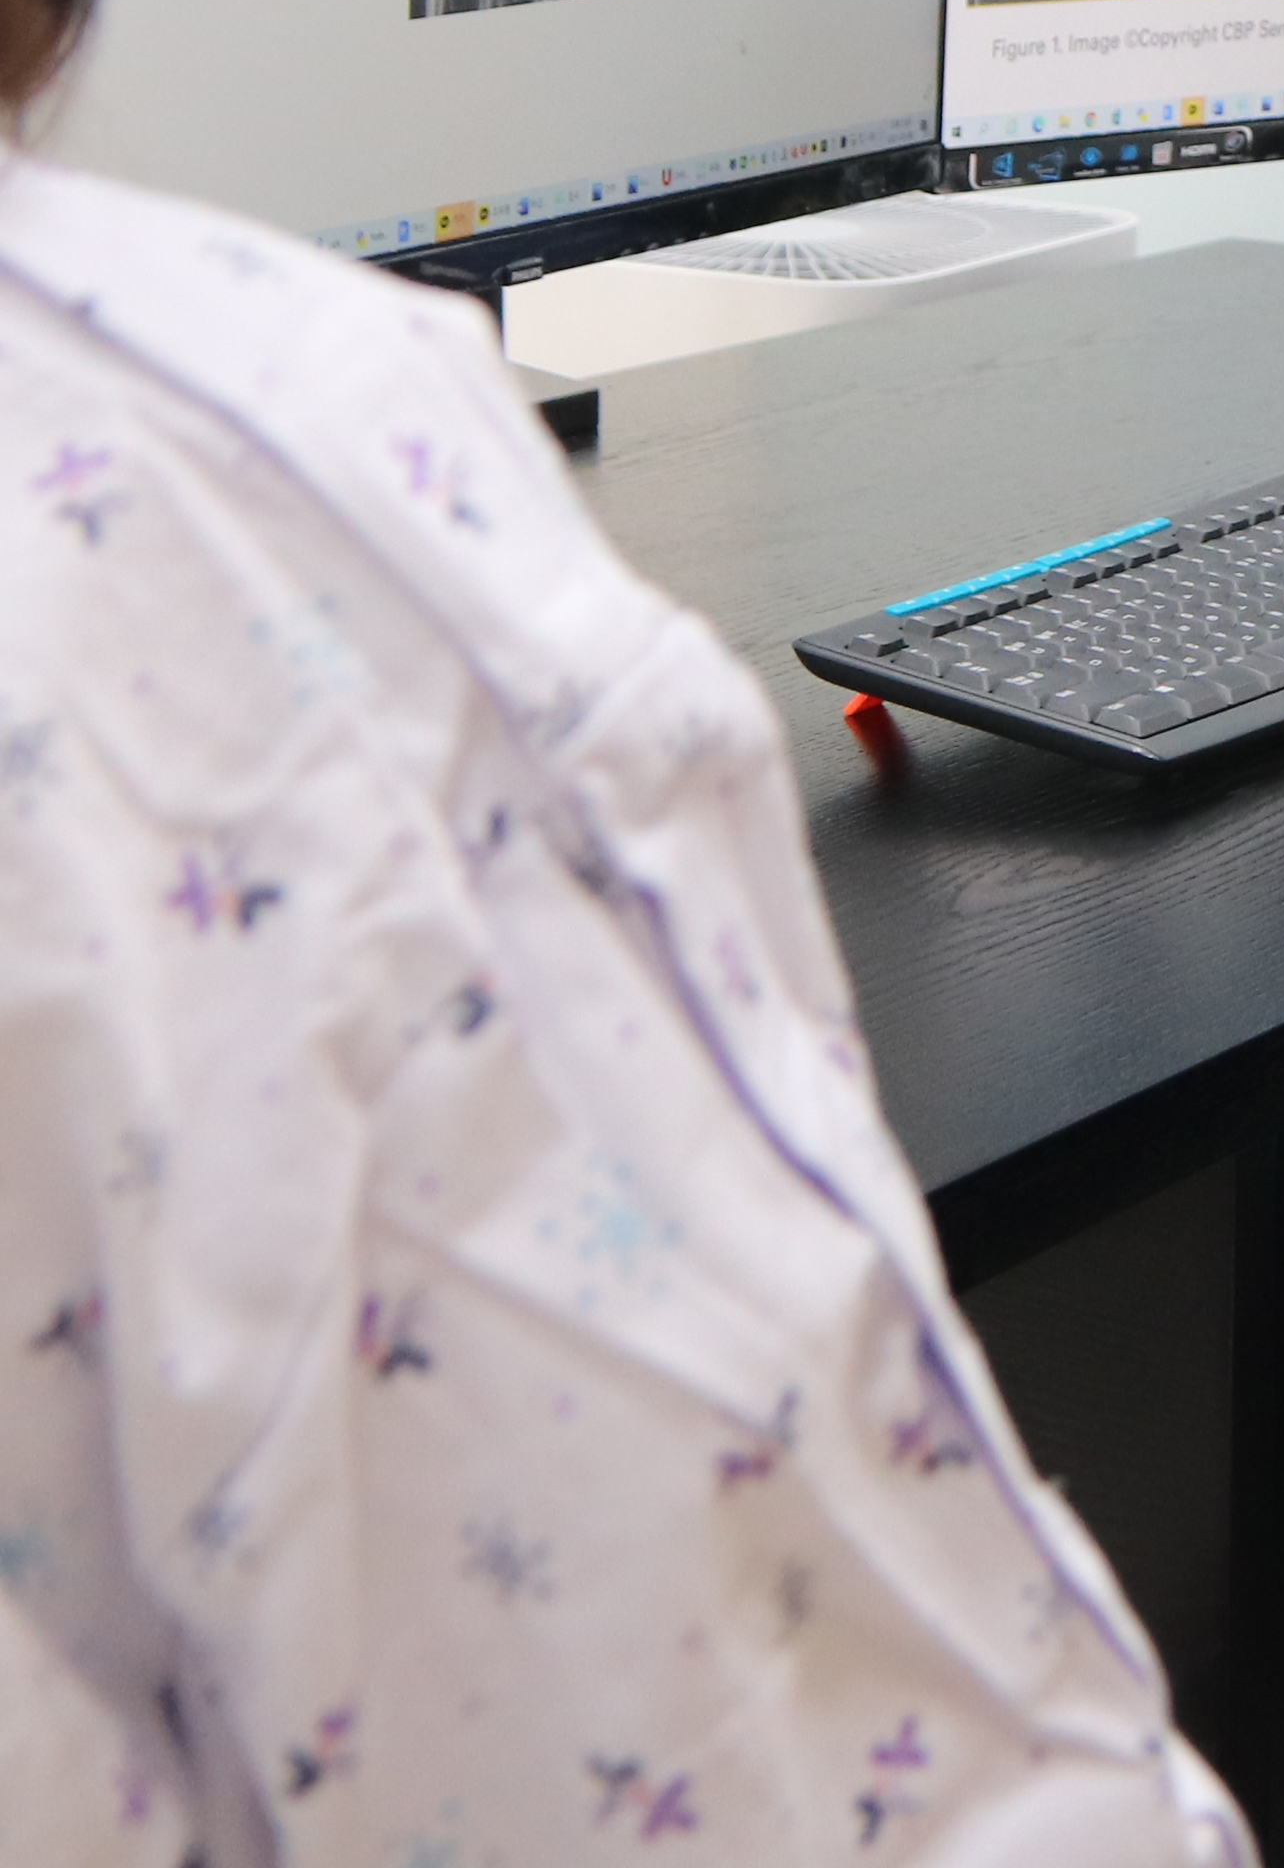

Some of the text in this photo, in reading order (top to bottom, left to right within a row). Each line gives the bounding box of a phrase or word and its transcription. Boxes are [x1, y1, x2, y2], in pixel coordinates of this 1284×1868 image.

[992, 37, 1045, 62] Figure
[1069, 32, 1119, 56] Image
[1222, 22, 1255, 41] CBP
